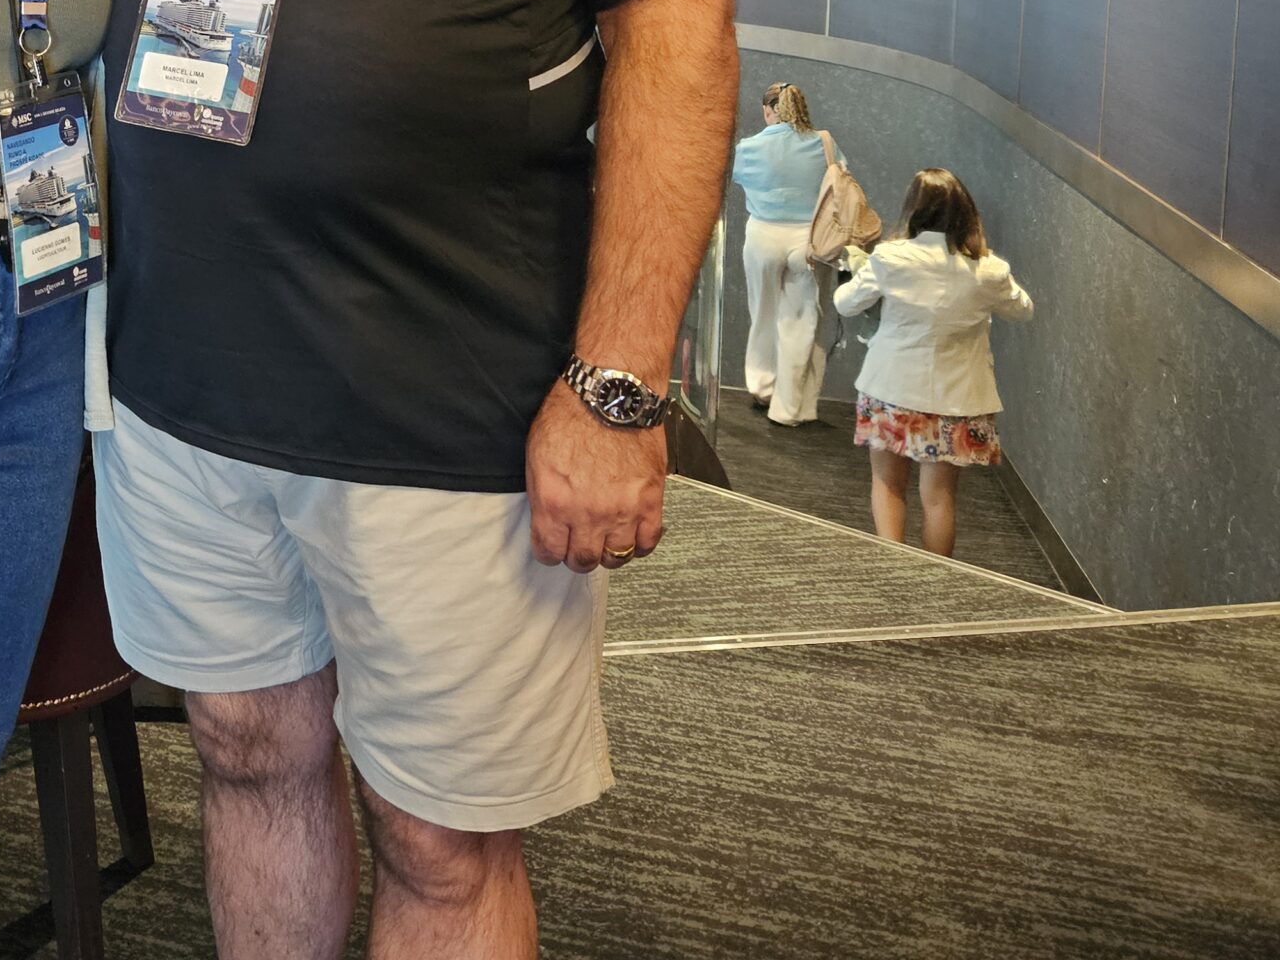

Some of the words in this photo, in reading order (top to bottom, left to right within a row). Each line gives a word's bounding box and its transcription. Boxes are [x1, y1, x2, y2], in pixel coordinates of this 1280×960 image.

[162, 65, 188, 76] MARCEL
[189, 70, 205, 78] LIMA
[17, 112, 32, 124] MSC
